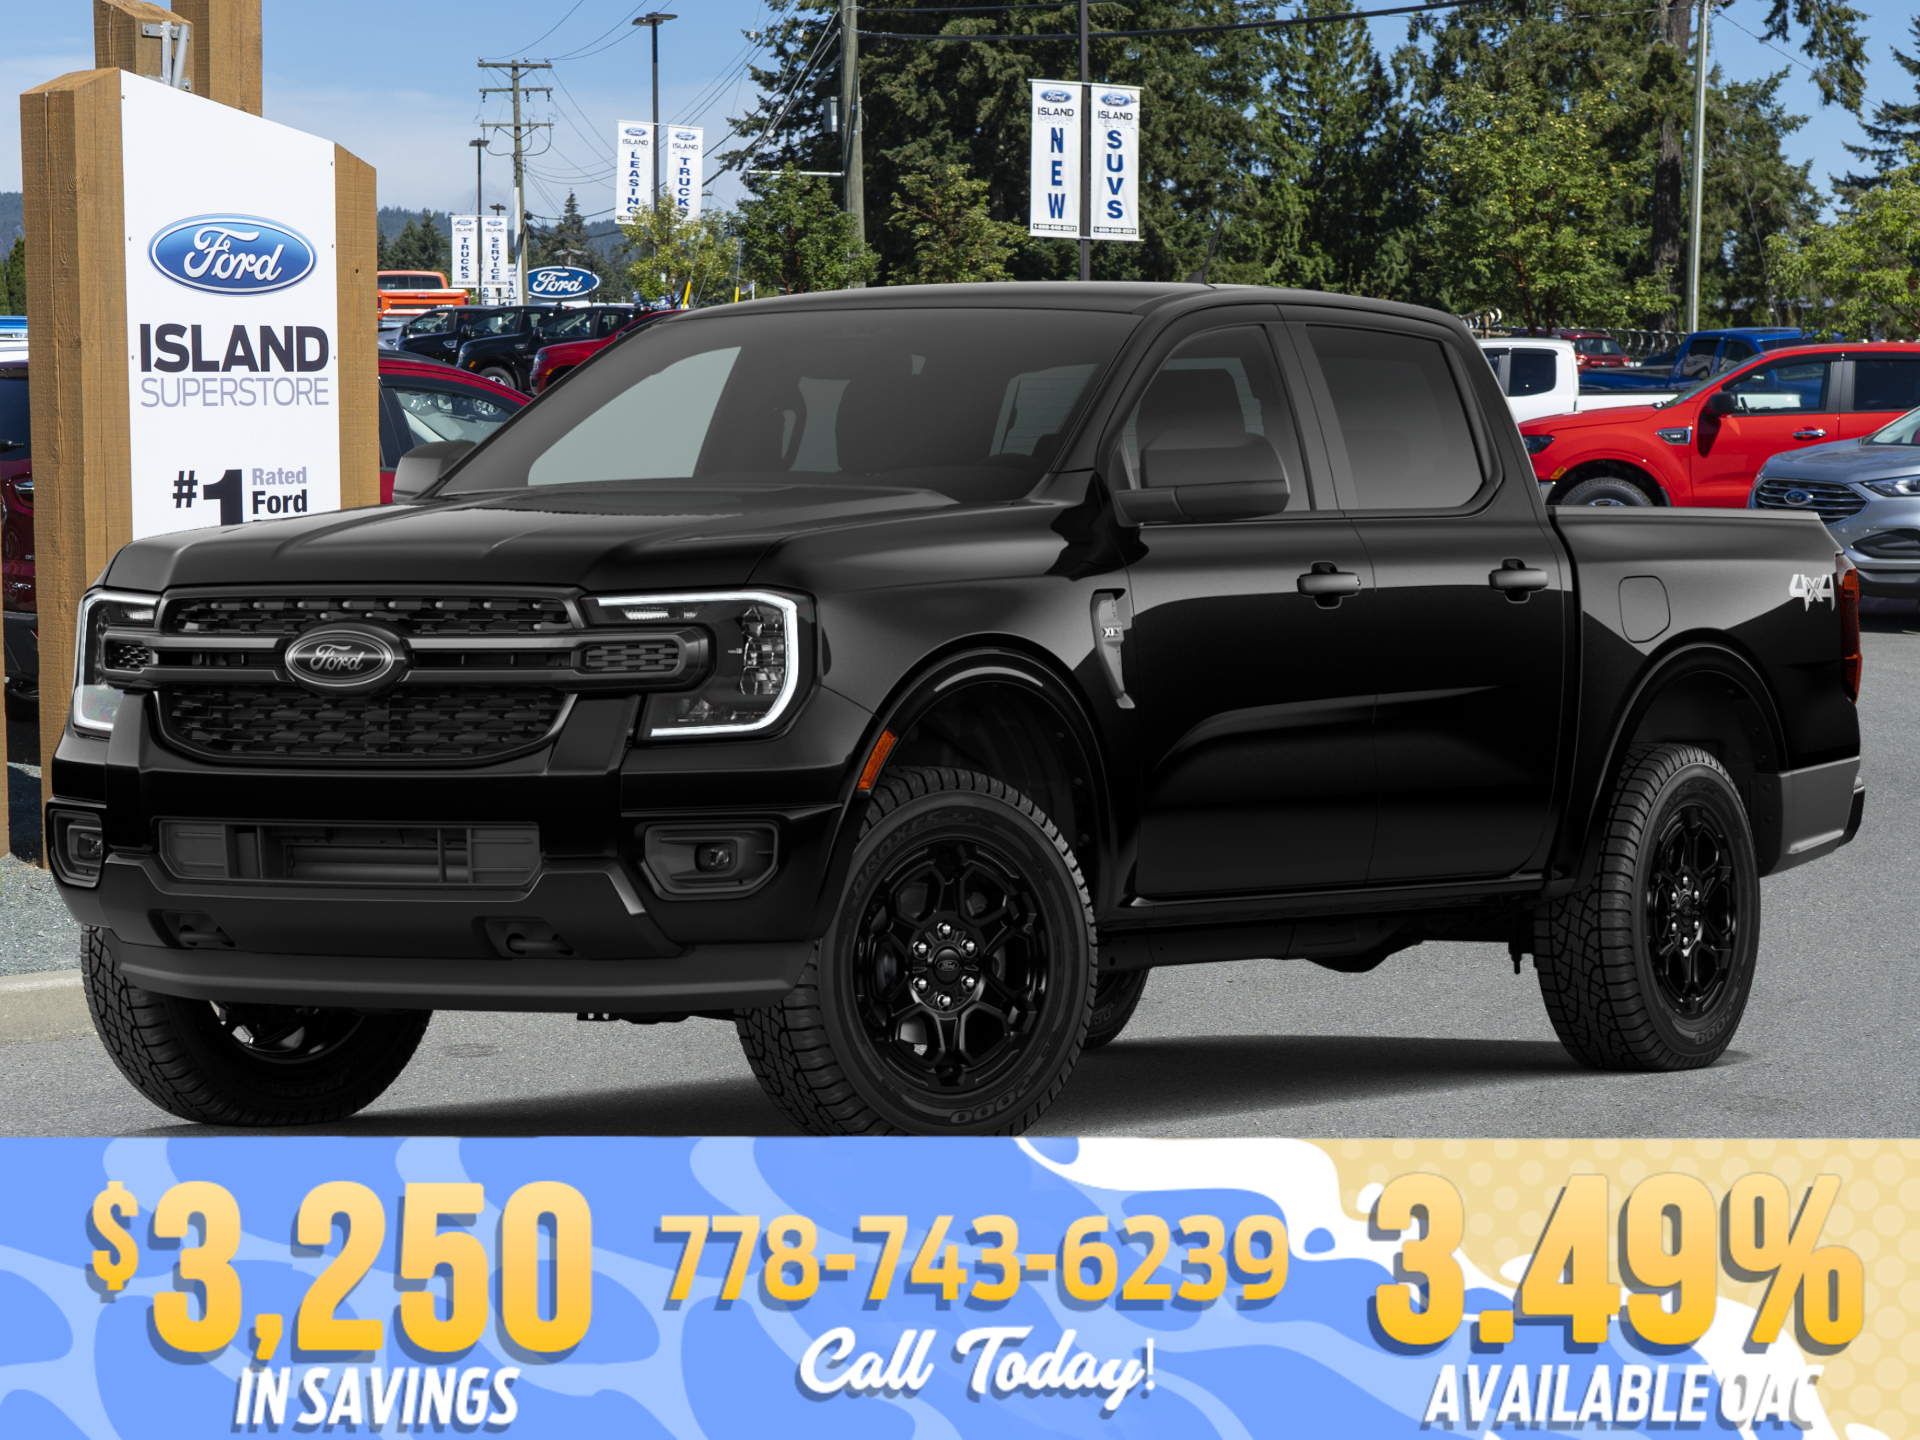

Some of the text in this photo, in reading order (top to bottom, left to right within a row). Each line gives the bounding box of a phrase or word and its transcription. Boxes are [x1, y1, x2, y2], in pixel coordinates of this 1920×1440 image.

[1038, 107, 1074, 117] ISLAND
[1098, 110, 1133, 121] ISLAND
[672, 143, 699, 151] ISLAND
[626, 151, 641, 215] LEASING
[1048, 127, 1066, 219] NEW
[1106, 130, 1124, 219] SUVS
[184, 226, 285, 282] Ford
[460, 237, 470, 280] TRUCKS
[491, 237, 500, 281] SERVICE
[532, 270, 584, 293] Ford
[140, 323, 329, 373] ISLAND
[141, 376, 329, 408] SUPERSTORE
[252, 466, 307, 486] Rated
[252, 489, 308, 515] Ford
[309, 644, 365, 671] Ford
[950, 1074, 1033, 1124] 2000
